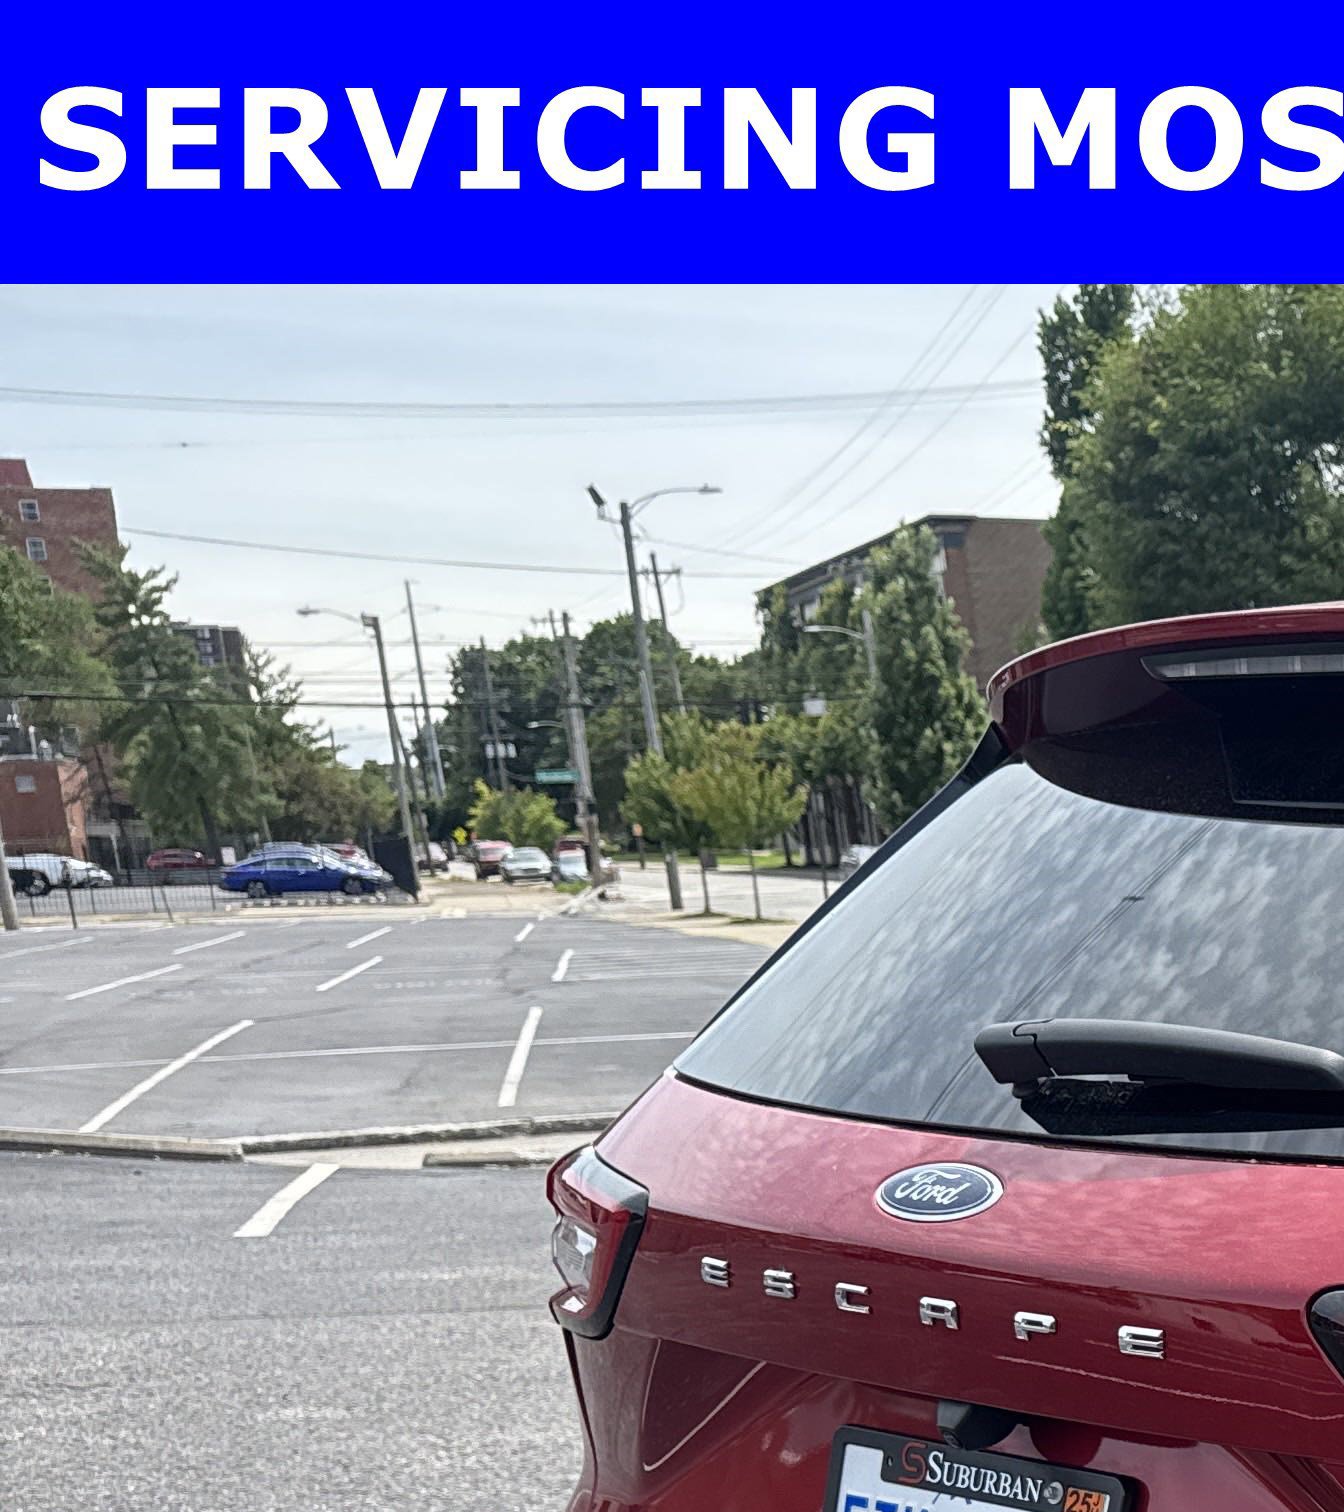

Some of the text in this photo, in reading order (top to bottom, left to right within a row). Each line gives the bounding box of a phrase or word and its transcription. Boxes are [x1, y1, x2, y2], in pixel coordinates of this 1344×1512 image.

[894, 1168, 972, 1206] Ford
[700, 1256, 1166, 1359] ESCAPE
[926, 1450, 1043, 1503] SUBURBAN
